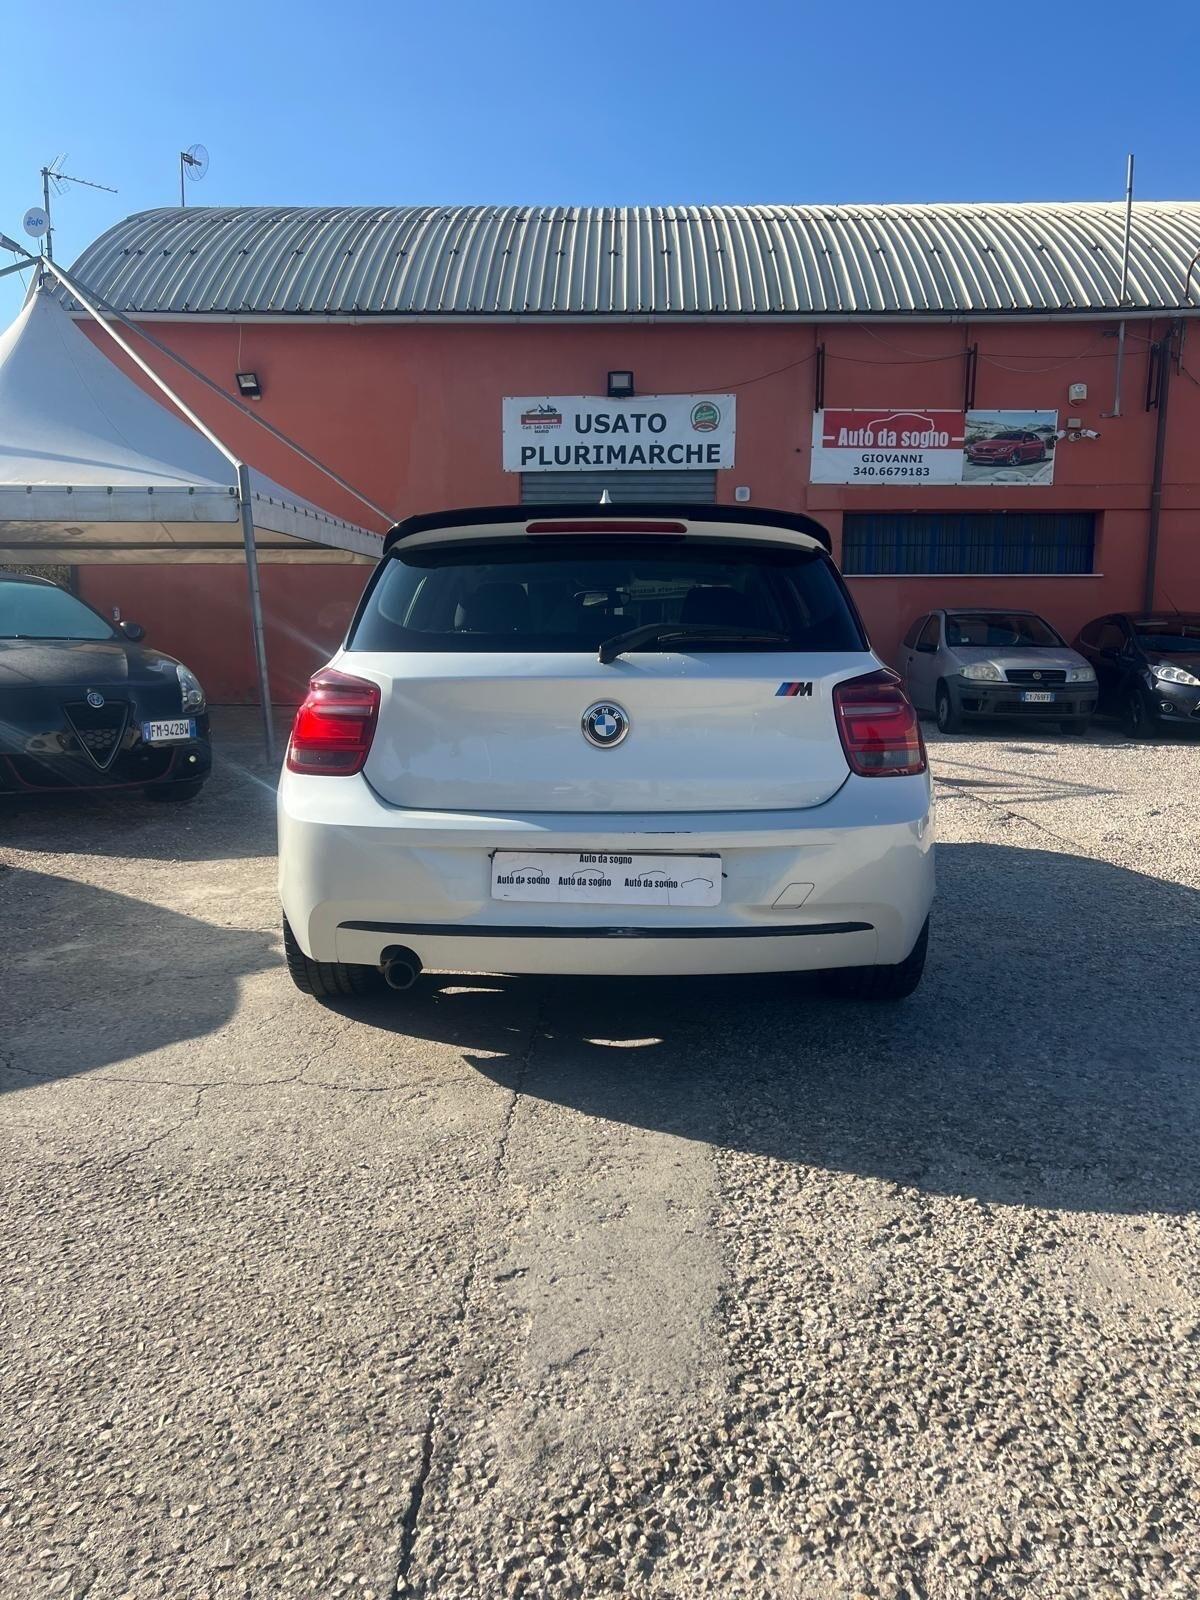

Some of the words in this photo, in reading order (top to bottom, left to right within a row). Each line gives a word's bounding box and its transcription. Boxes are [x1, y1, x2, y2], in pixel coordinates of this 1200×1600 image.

[574, 413, 667, 434] USATO
[838, 427, 873, 447] Auto
[878, 429, 897, 447] da
[901, 430, 949, 448] sogno
[521, 443, 721, 466] PLURIMARCHE
[861, 453, 924, 464] GIOVANNI
[853, 466, 930, 476] 340.6679183
[590, 708, 621, 720] BMW
[579, 854, 597, 863] Auto
[598, 854, 608, 864] da
[609, 855, 633, 865] sogno
[497, 875, 514, 885] Auto
[515, 875, 525, 884] da
[526, 876, 550, 885] sogno
[558, 876, 575, 886] Auto
[577, 876, 587, 886] da
[588, 877, 612, 887] sogno
[624, 878, 642, 888] Auto
[643, 878, 653, 888] da
[654, 879, 678, 889] sogno
